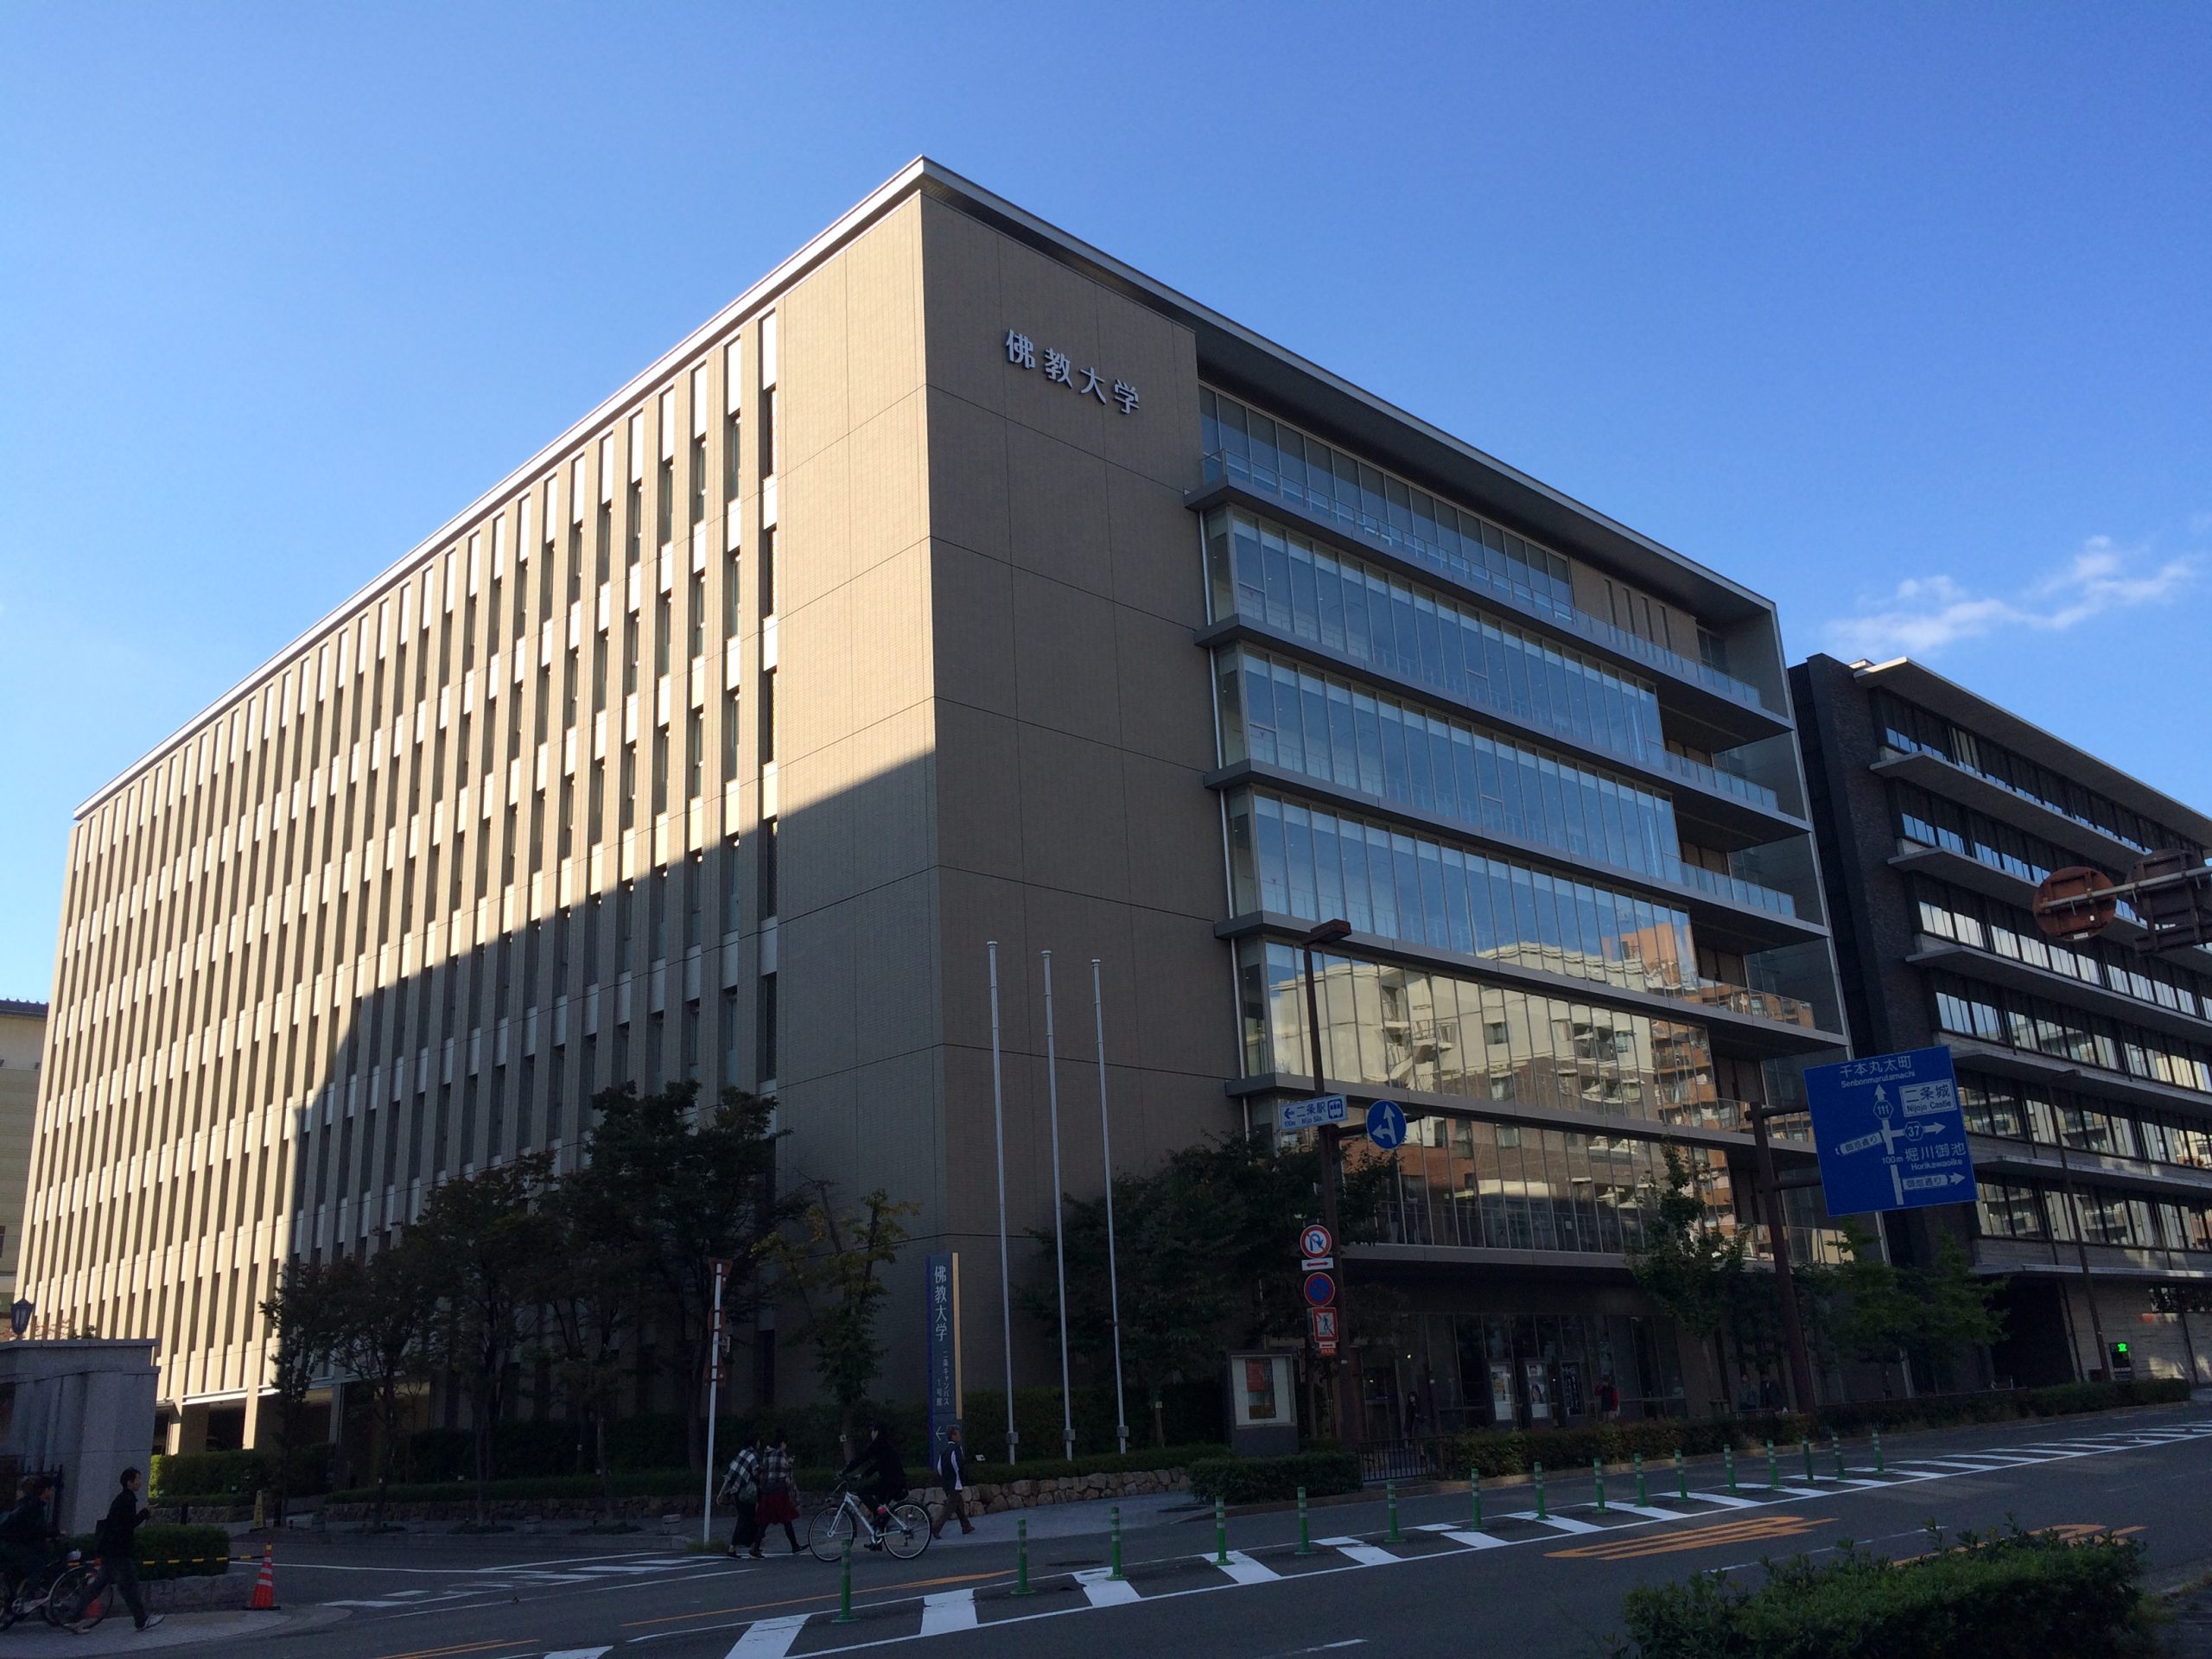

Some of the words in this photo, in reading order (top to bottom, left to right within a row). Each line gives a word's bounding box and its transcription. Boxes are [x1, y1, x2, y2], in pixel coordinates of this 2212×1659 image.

[1006, 328, 1140, 415] 佛教大学
[1840, 1055, 1912, 1078] 千本丸太町
[1904, 1084, 1951, 1103] 二条城
[1296, 1102, 1326, 1117] 二条駅
[1876, 1104, 1890, 1116] 111
[1929, 1100, 1952, 1109] Castle
[1907, 1125, 1920, 1137] 37
[1881, 1155, 1904, 1165] 100m
[1904, 1141, 1967, 1162] 堀川御池
[934, 1265, 948, 1342] 佛教大学
